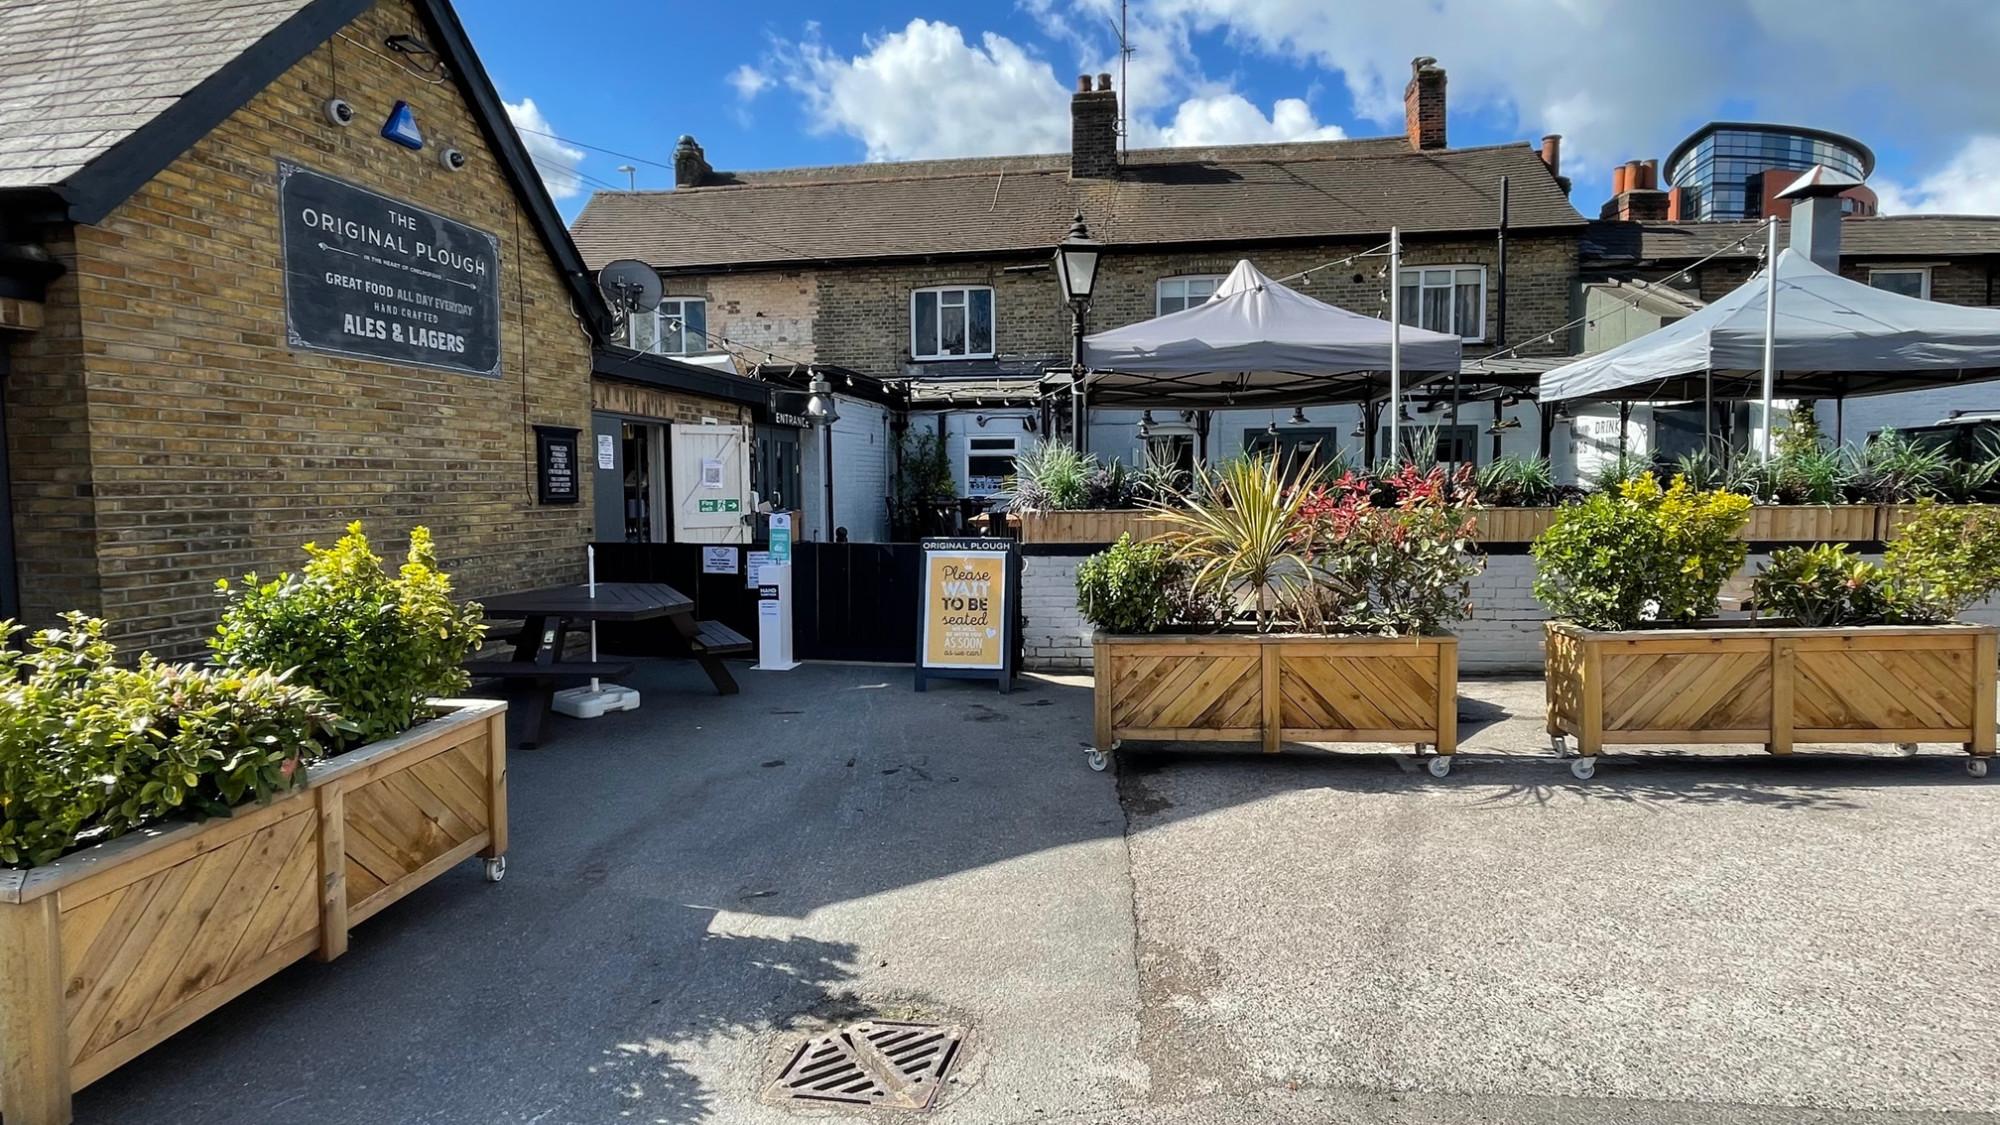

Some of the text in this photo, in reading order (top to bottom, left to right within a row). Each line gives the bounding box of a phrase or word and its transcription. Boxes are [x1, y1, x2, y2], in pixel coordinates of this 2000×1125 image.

[388, 210, 417, 231] THE
[302, 208, 486, 276] ORIGINAL PLOUGH
[371, 256, 382, 264] THE
[383, 259, 400, 268] HEART
[326, 272, 472, 316] GREAT FOOD ALL DAY EVERYDAY
[374, 302, 438, 324] HAND CRAFTED
[344, 313, 464, 353] ALES & LAGERS
[776, 412, 809, 428] ENTRANCE
[970, 542, 1010, 550] PLOUGH
[942, 565, 992, 581] Please
[941, 582, 991, 598] WAIT
[942, 598, 988, 611] TO BE
[942, 612, 988, 626] seated
[944, 638, 983, 649] AS SOON
